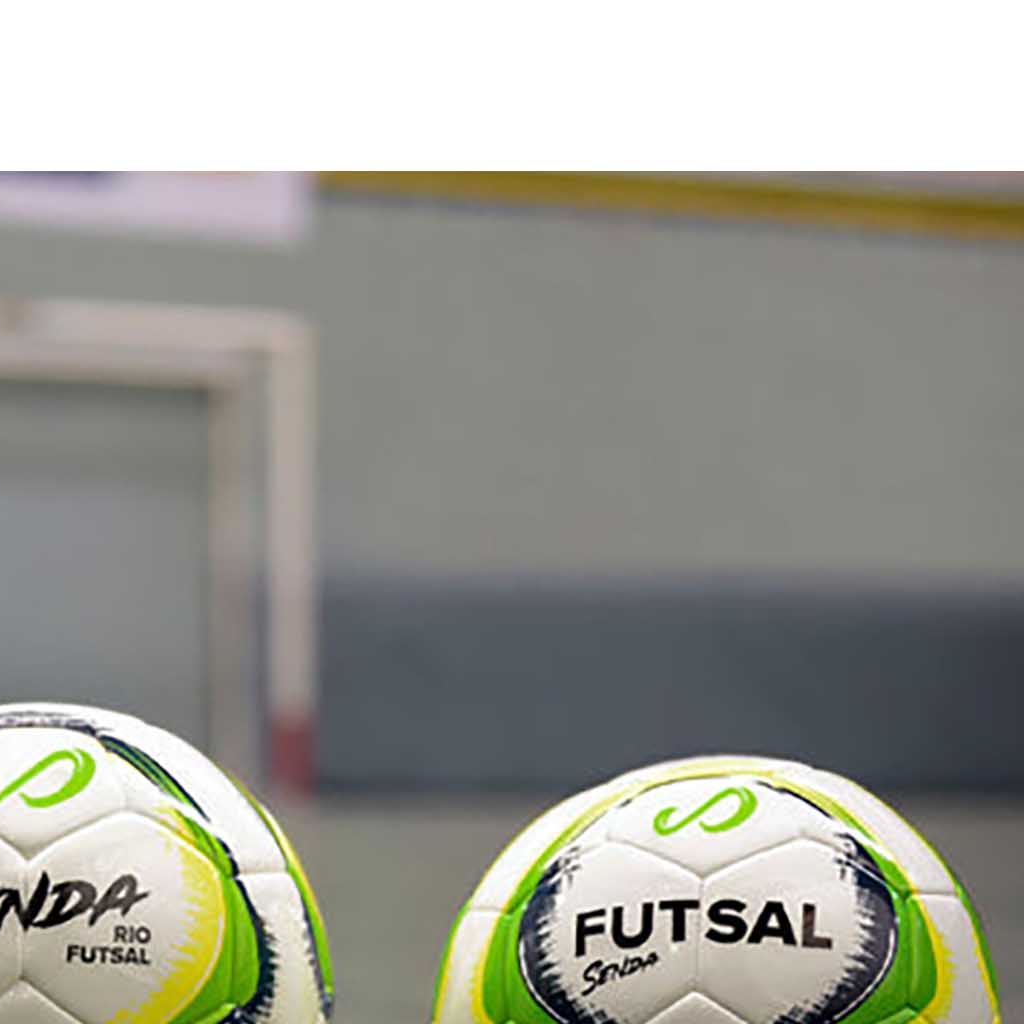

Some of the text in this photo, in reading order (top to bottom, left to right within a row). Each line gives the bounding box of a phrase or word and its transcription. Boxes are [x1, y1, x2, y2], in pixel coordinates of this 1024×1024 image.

[113, 925, 152, 943] RIO
[575, 899, 833, 957] FUTSAL
[66, 945, 151, 965] FUTSAL
